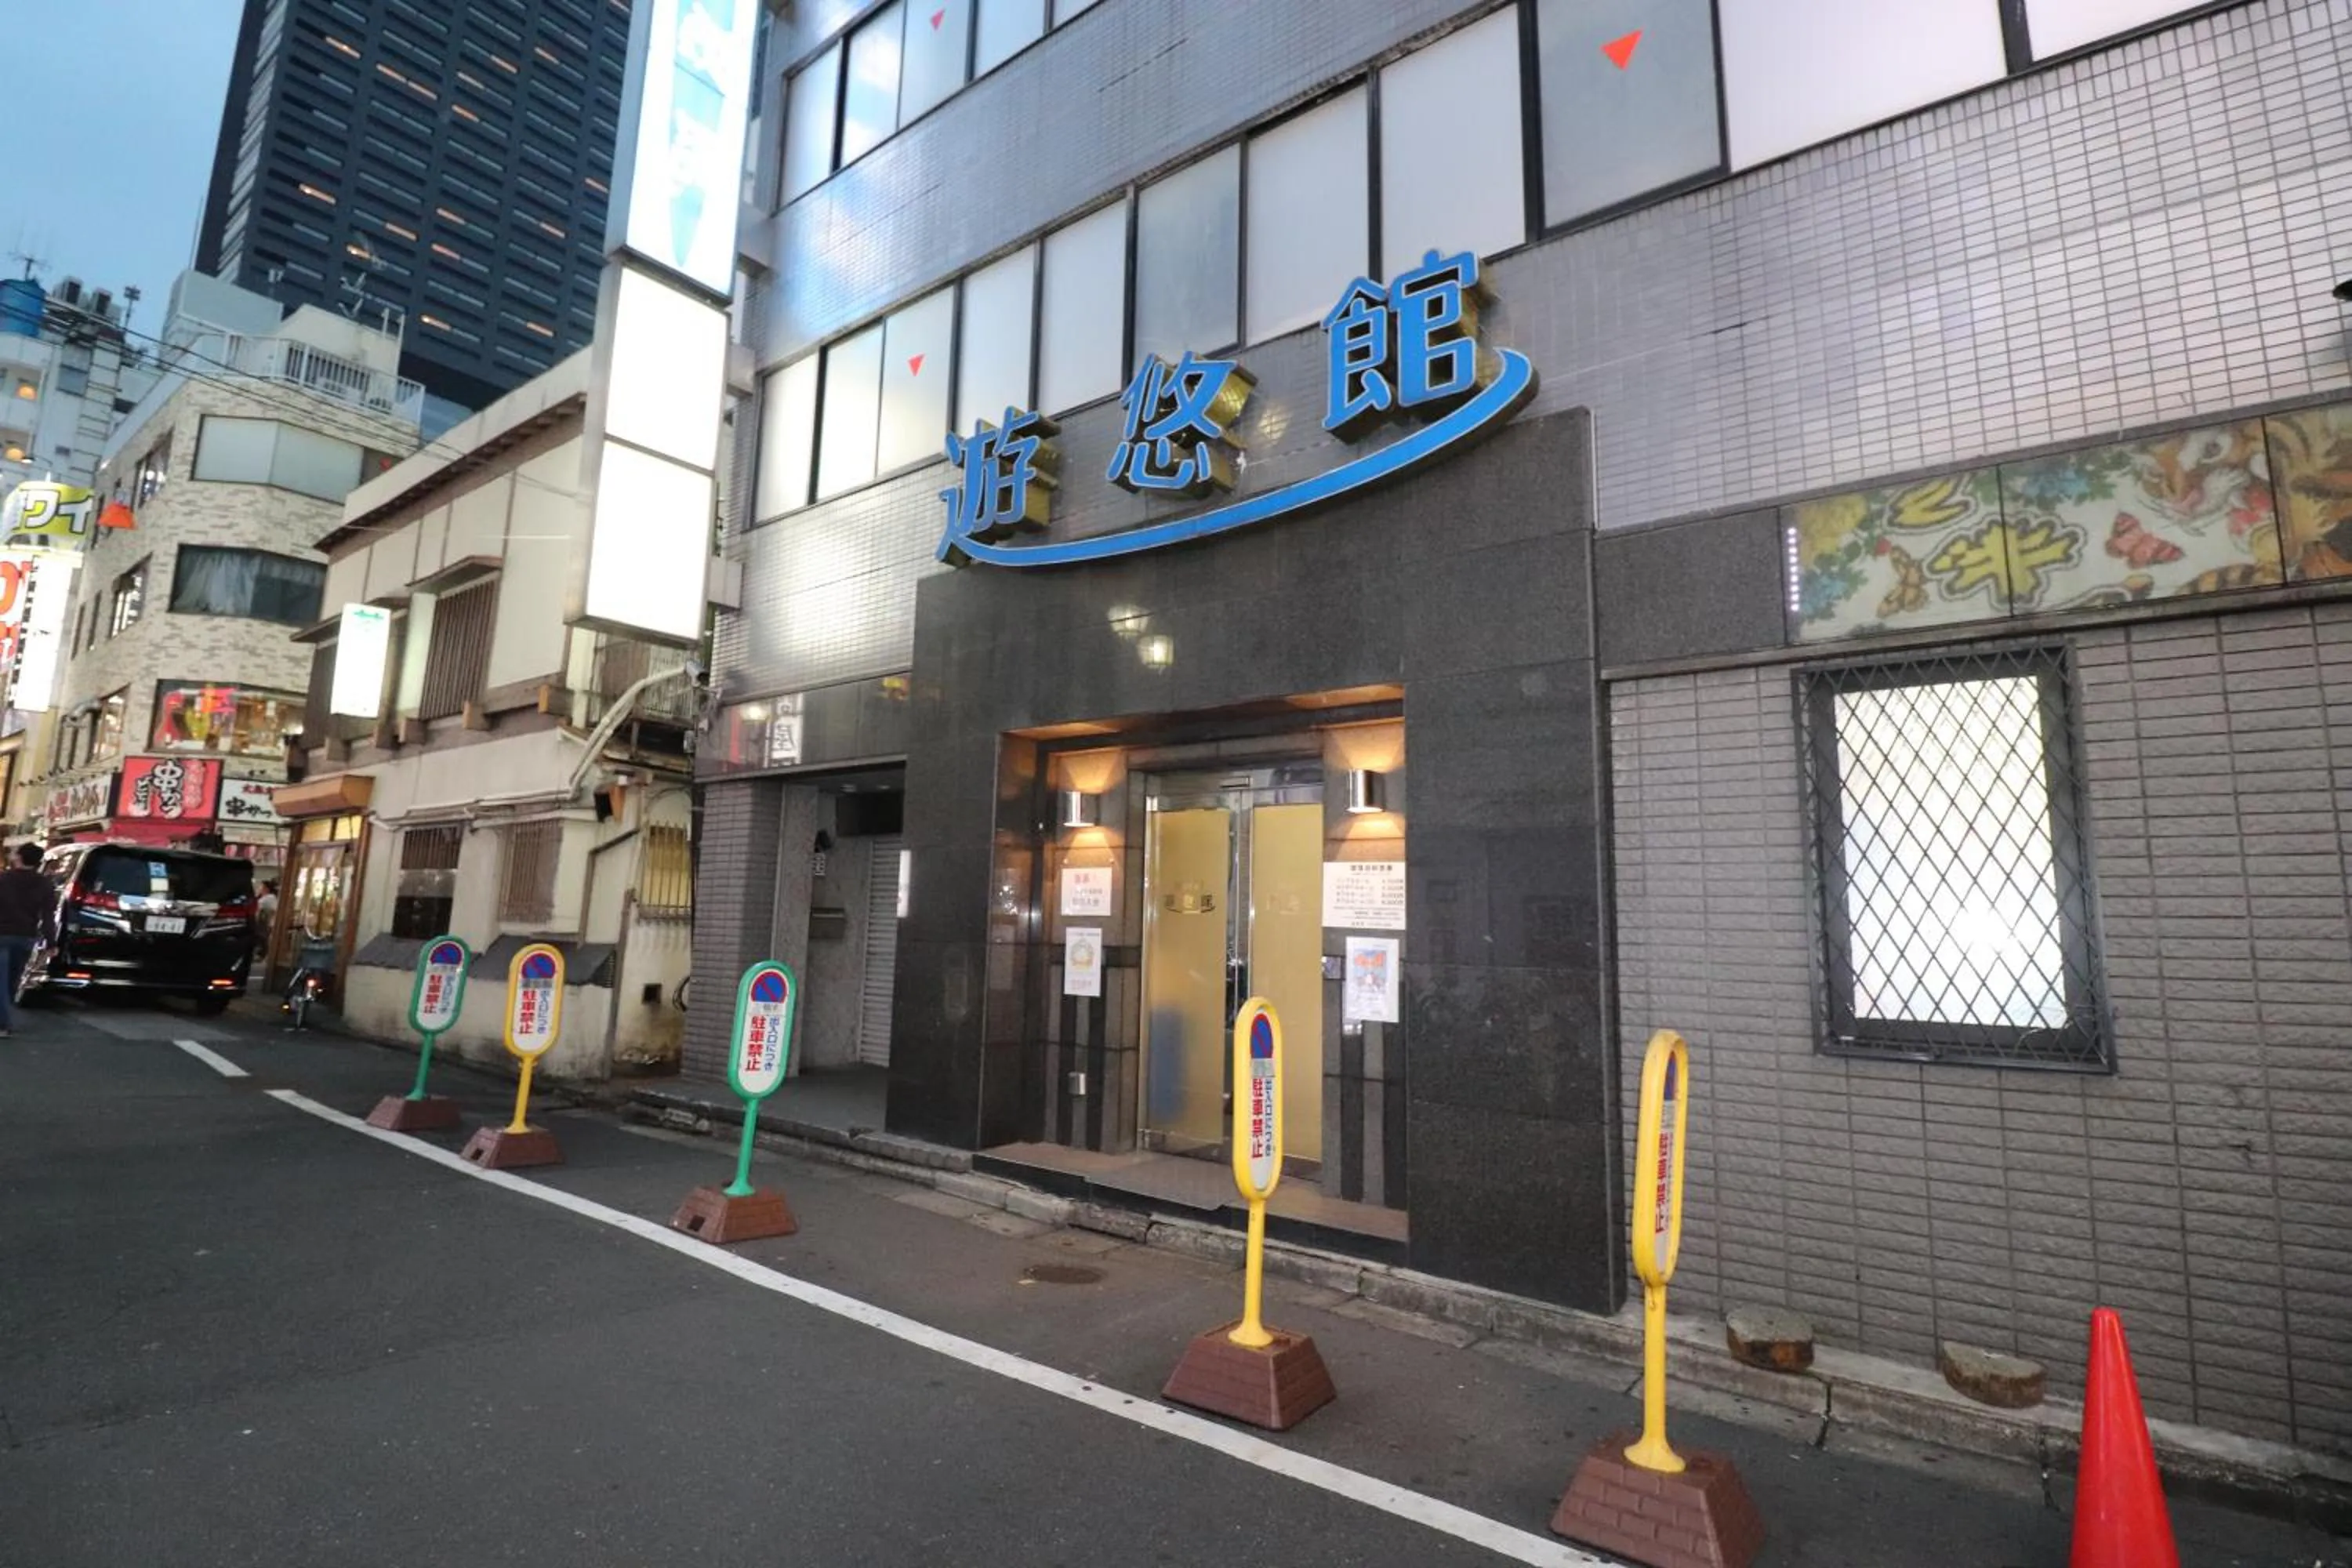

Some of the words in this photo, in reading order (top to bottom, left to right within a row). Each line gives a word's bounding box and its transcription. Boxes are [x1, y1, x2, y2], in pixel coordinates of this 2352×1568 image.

[935, 249, 1480, 563] 遊悠館
[225, 796, 273, 818] 串かつ
[519, 989, 537, 1034] 駐車禁止
[745, 1015, 766, 1072] 駐車禁止
[764, 1017, 780, 1072] 出入口につき
[1252, 1078, 1264, 1159] 駐車禁止
[1265, 1078, 1273, 1156] 出入口につき
